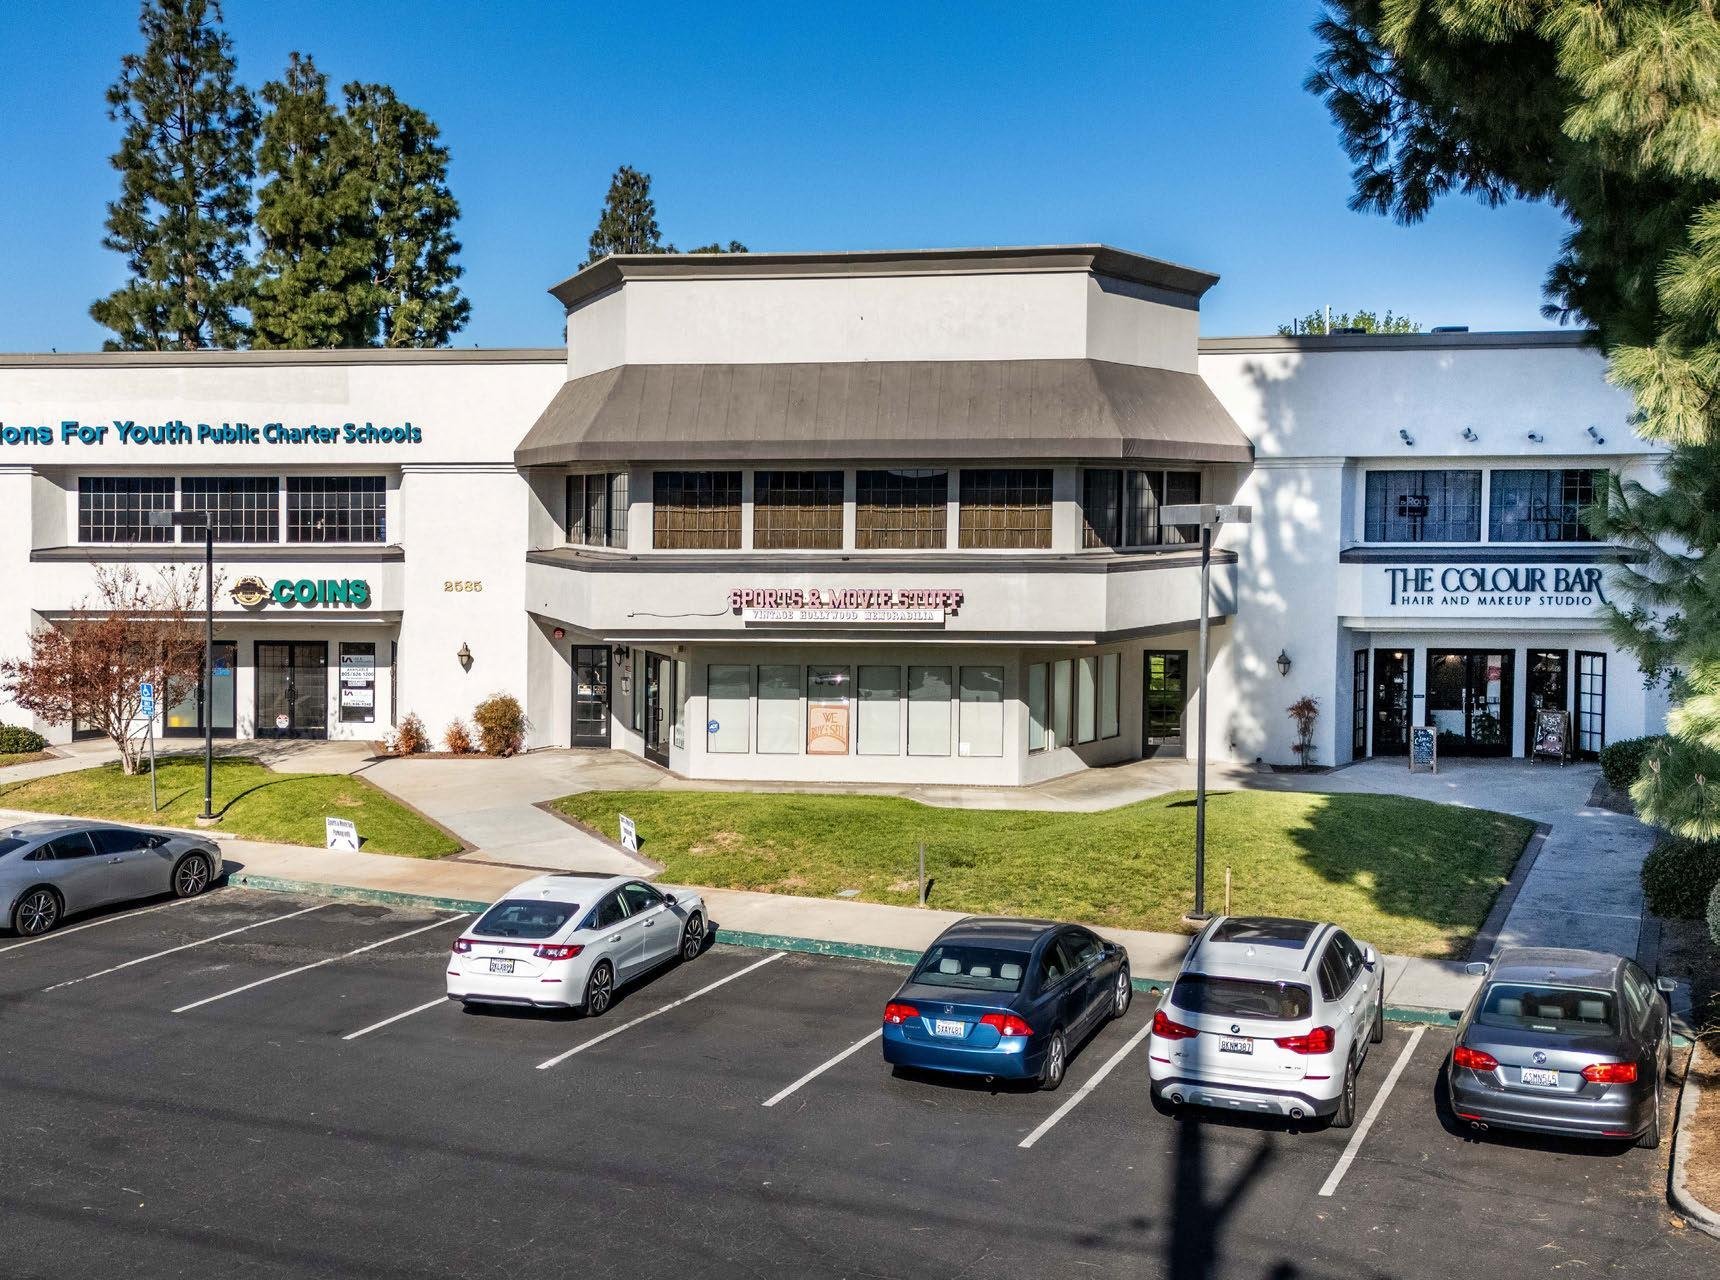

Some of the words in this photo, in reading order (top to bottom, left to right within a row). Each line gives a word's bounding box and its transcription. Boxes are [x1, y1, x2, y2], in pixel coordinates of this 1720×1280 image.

[61, 421, 107, 444] For
[113, 420, 192, 444] Youth
[198, 423, 259, 444] Public
[263, 423, 340, 444] Charter
[343, 422, 422, 444] Schools
[274, 579, 369, 604] COINS
[444, 580, 483, 592] 2585
[1385, 567, 1434, 605] THE
[1441, 567, 1548, 593] COLOUR
[1554, 567, 1613, 605] BAR
[730, 589, 803, 609] SPORTS
[808, 589, 822, 609] &
[828, 589, 892, 609] MOVIE
[899, 589, 963, 609] STUFF
[1401, 596, 1434, 606] HAIR
[1441, 596, 1469, 606] AND
[1478, 596, 1531, 606] MAKEUP
[1539, 596, 1592, 606] STUDIO
[753, 610, 794, 619] VINTAGE
[800, 610, 858, 620] HOLLYWOOD
[865, 611, 934, 620] MEMORABILIA
[823, 712, 838, 723] WE
